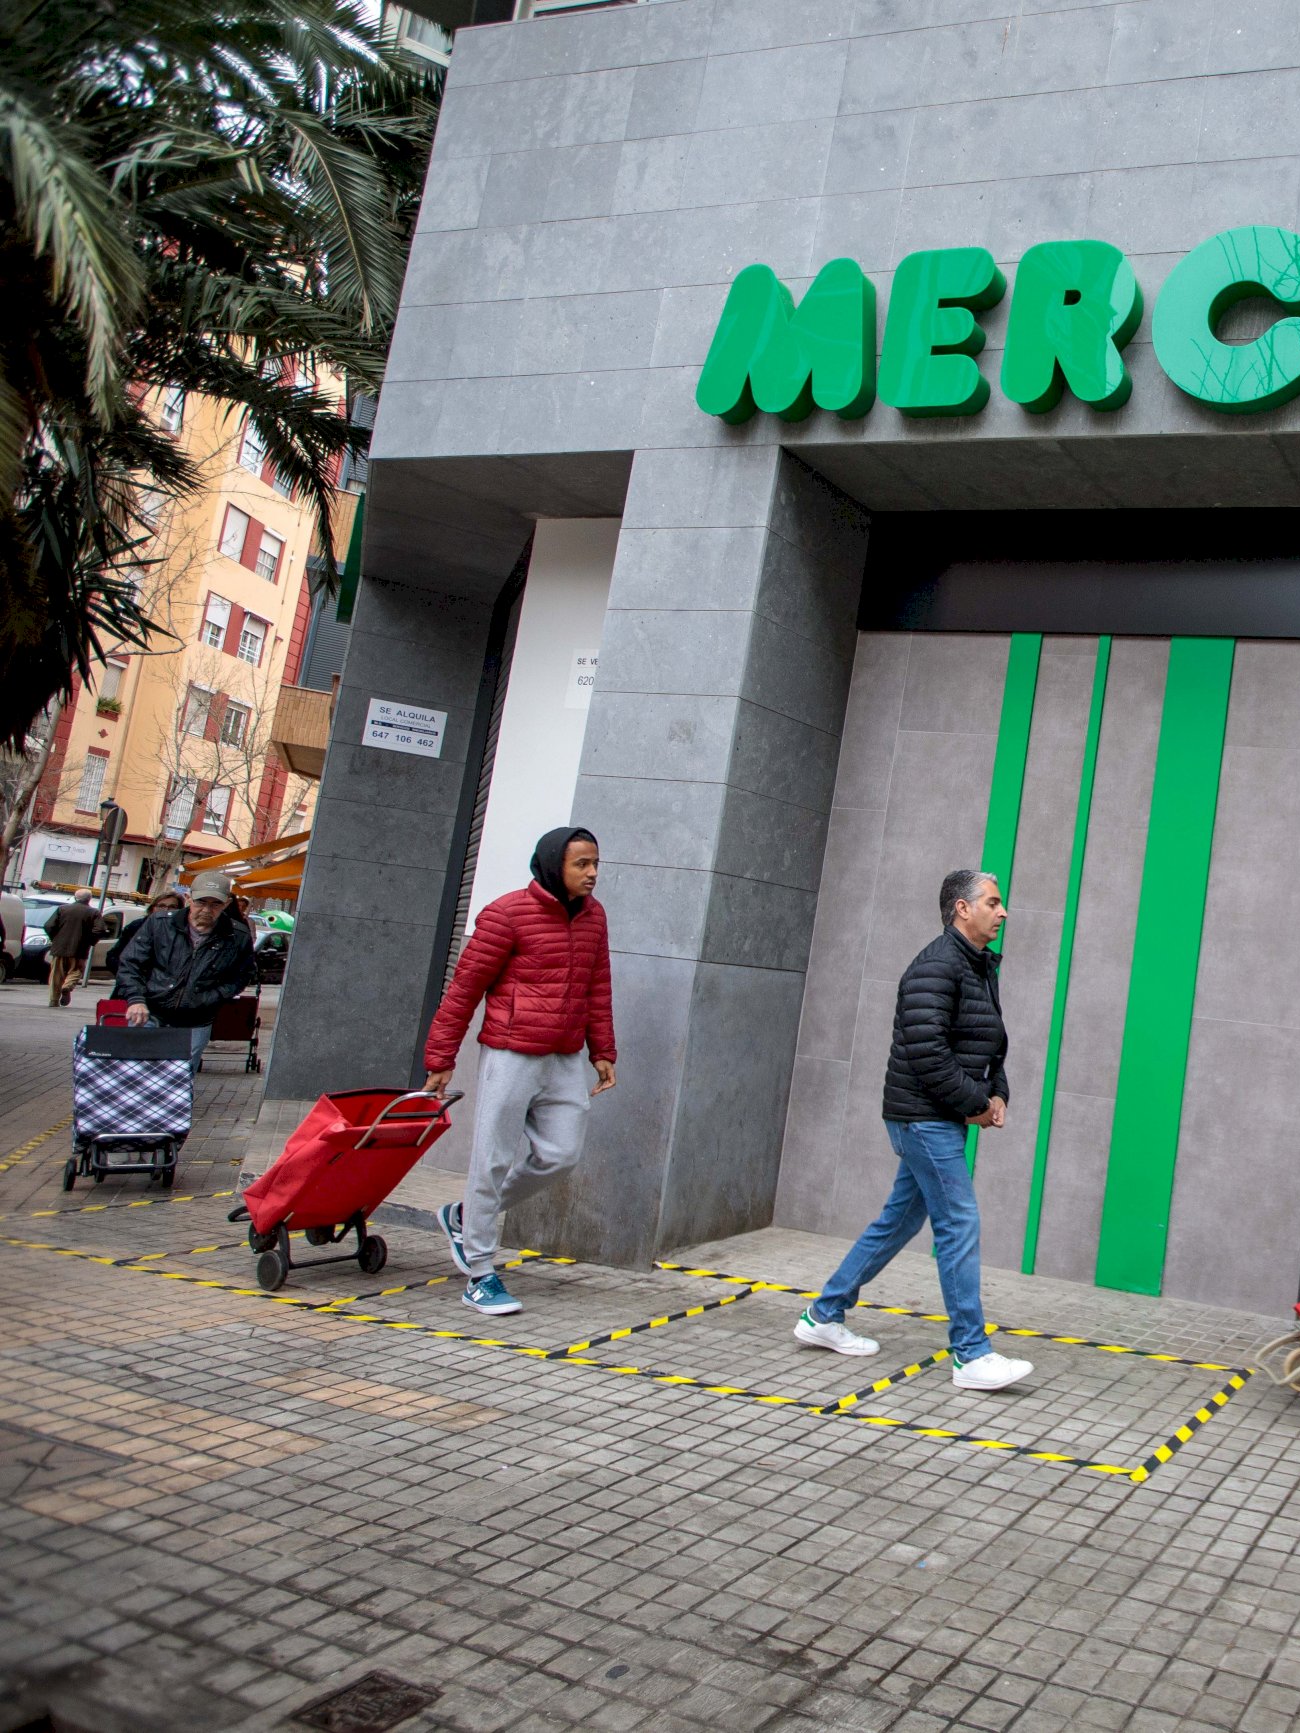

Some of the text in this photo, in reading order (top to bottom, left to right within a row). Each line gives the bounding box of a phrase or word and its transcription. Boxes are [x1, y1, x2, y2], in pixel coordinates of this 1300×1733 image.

[577, 676, 594, 685] 620
[379, 706, 436, 723] SE ALQUILA
[380, 715, 398, 723] LOCAL
[372, 730, 434, 747] 647 106 462
